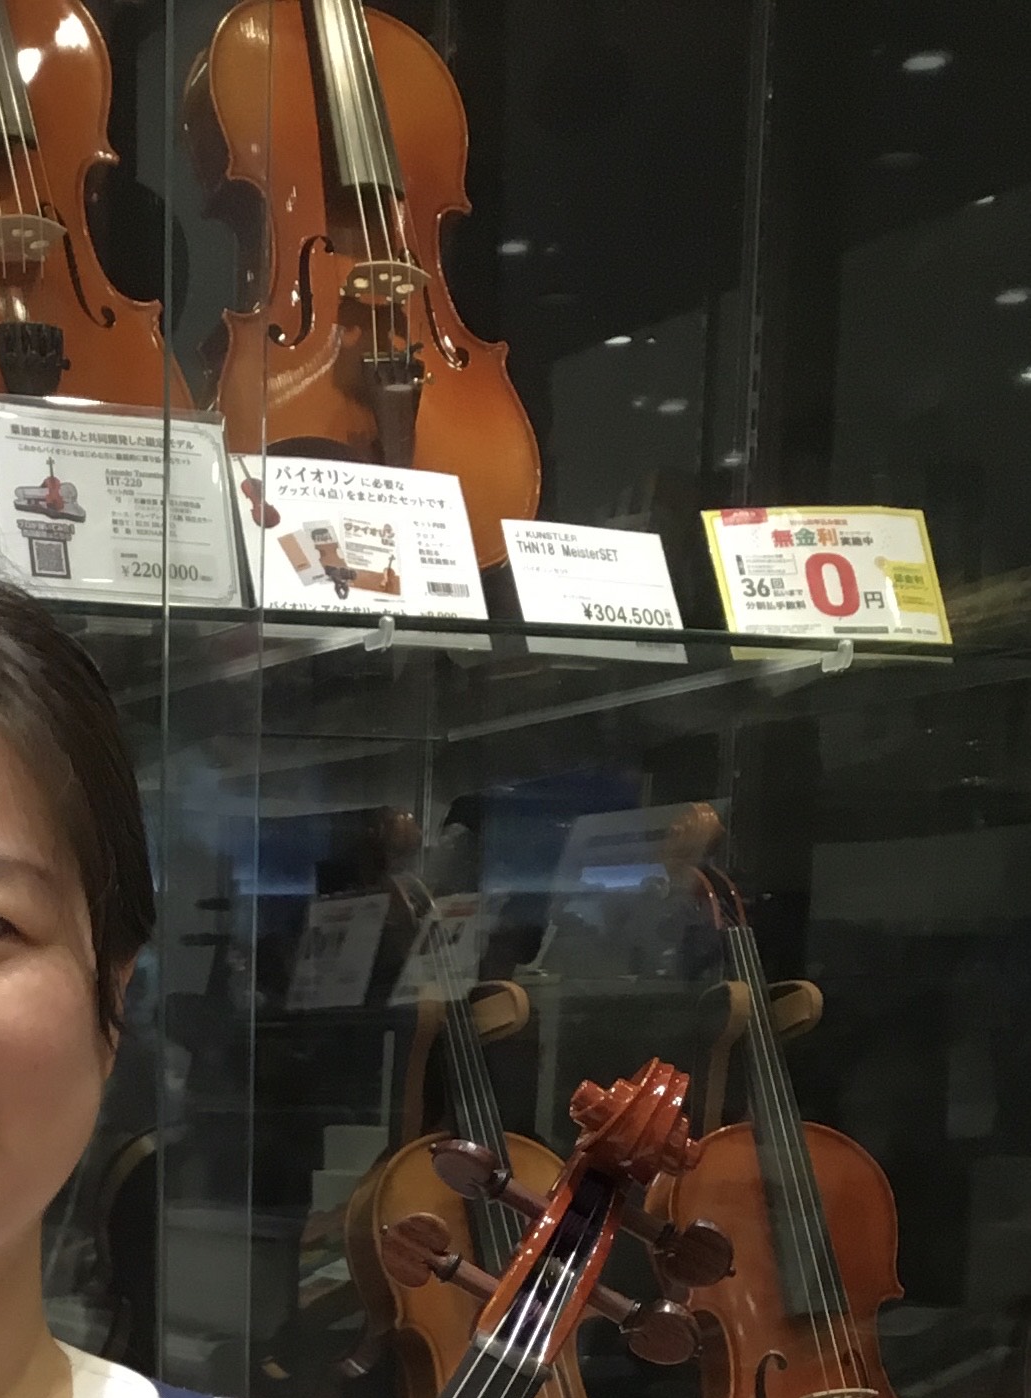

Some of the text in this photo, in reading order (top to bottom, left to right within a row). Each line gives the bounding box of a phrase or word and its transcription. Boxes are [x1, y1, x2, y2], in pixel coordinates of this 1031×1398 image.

[106, 476, 142, 488] HT-220
[516, 540, 618, 562] THN18 MeisterSET
[121, 561, 199, 581] ¥220000
